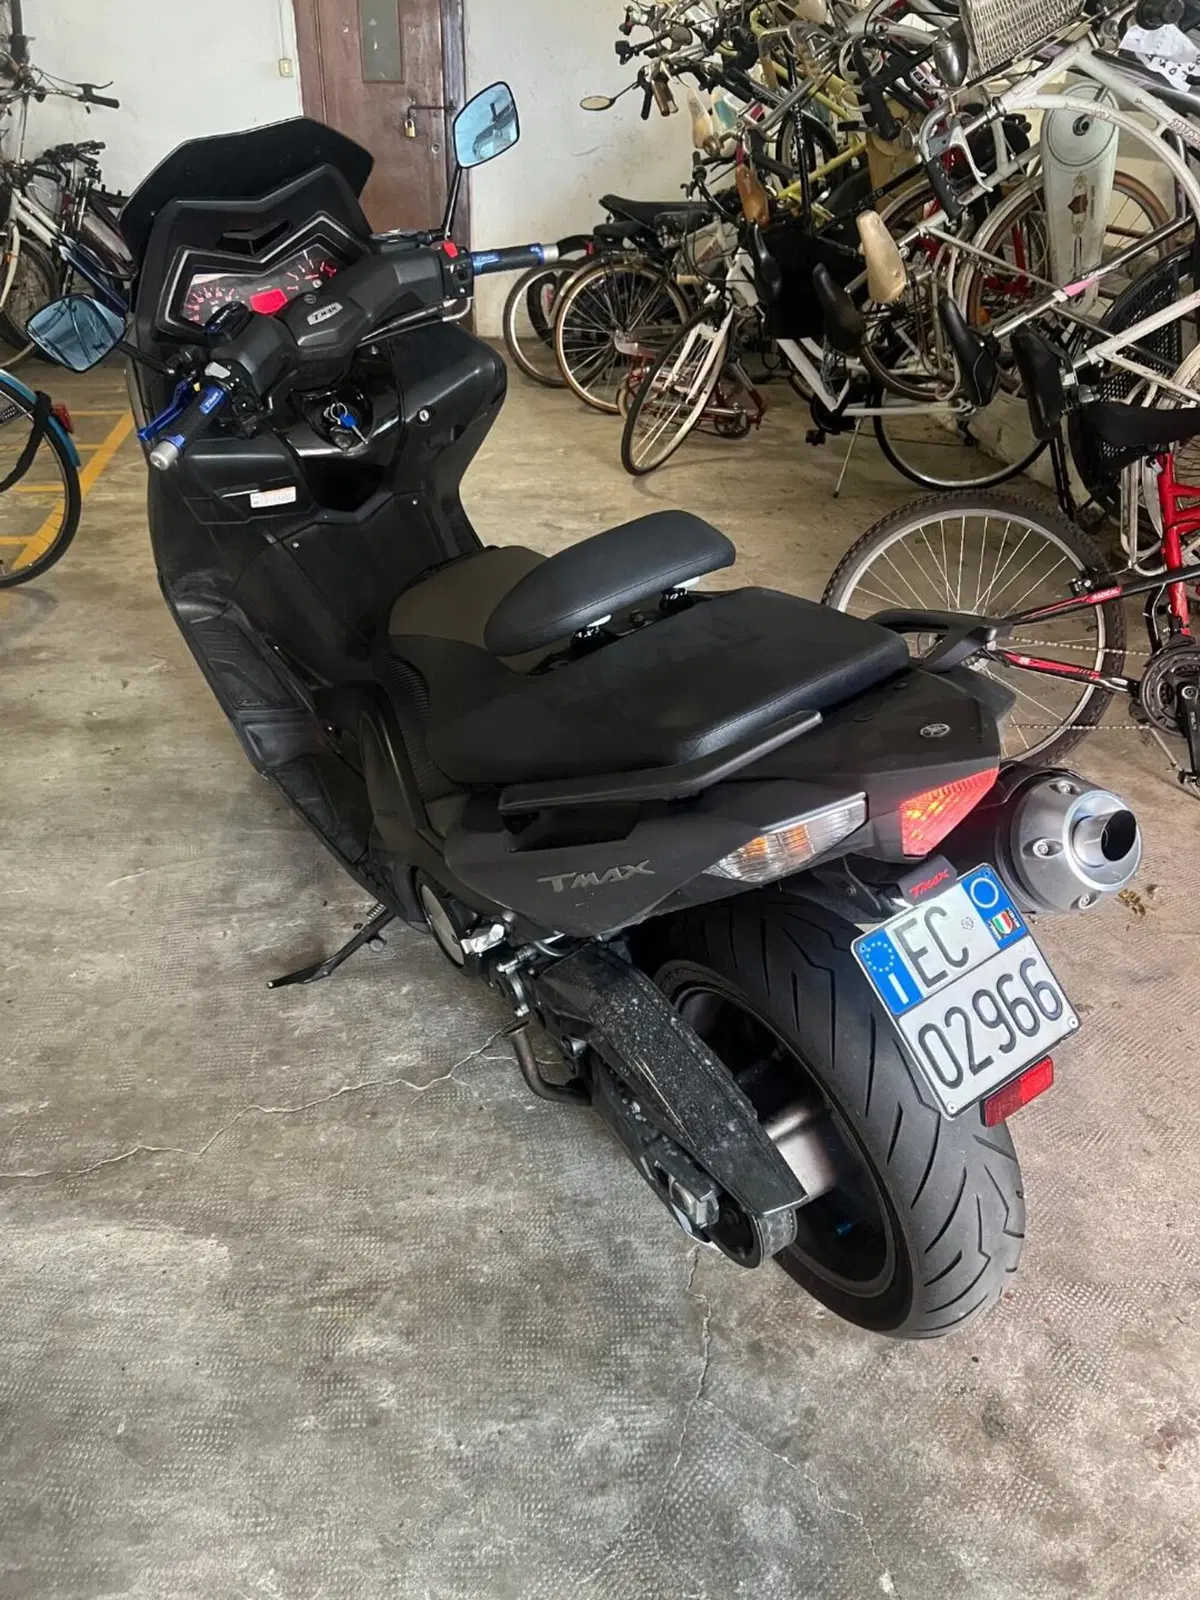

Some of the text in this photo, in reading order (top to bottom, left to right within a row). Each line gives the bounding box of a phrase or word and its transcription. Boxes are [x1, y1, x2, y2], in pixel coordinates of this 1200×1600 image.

[537, 859, 656, 892] TMAX
[893, 905, 969, 988] EC
[917, 957, 1064, 1090] 02966
